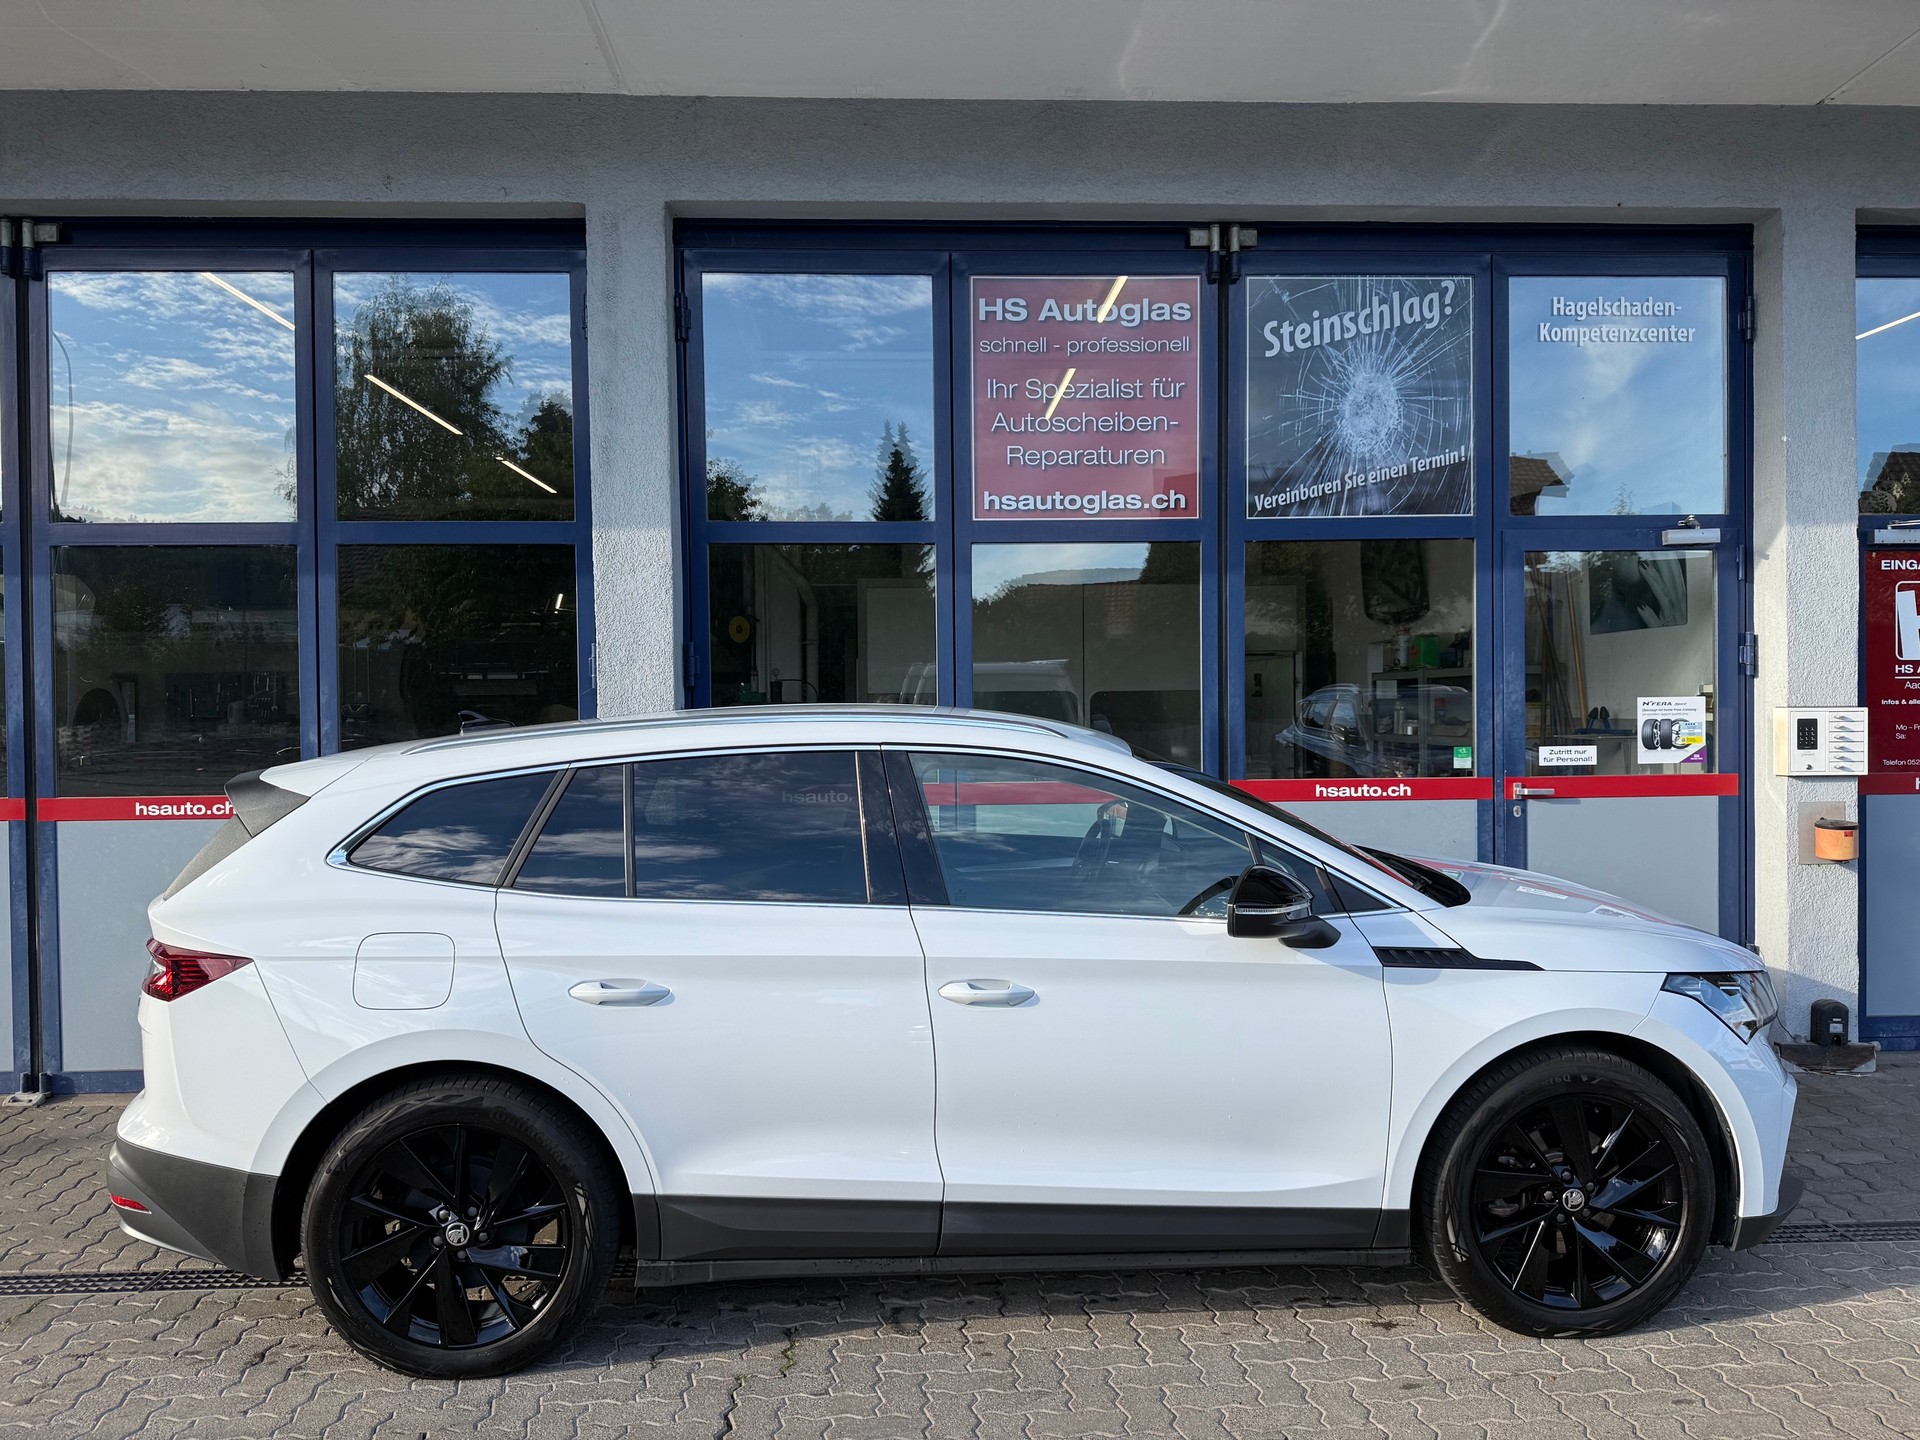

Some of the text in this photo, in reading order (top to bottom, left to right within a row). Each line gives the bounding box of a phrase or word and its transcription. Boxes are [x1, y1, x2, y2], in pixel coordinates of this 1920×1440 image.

[978, 297, 1192, 327] HS Autoglas
[1263, 280, 1455, 358] Steinschlag?
[1552, 296, 1682, 321] Hagelschaden-
[979, 337, 1047, 353] schnell
[1067, 336, 1190, 356] professionell
[1539, 322, 1696, 347] Kompetenzcenter
[987, 377, 1185, 403] Ihr Spezialist für
[991, 411, 1179, 432] Autoscheiben-
[1006, 445, 1165, 470] Reparaturen
[1254, 479, 1341, 511] Vereinbaren
[1344, 471, 1366, 490] Sie
[1369, 462, 1408, 484] einen
[983, 490, 1186, 515] hsautoglas.ch
[1895, 664, 1914, 674] HS
[1315, 783, 1412, 798] hsauto.ch
[135, 801, 237, 816] hsauto.ch
